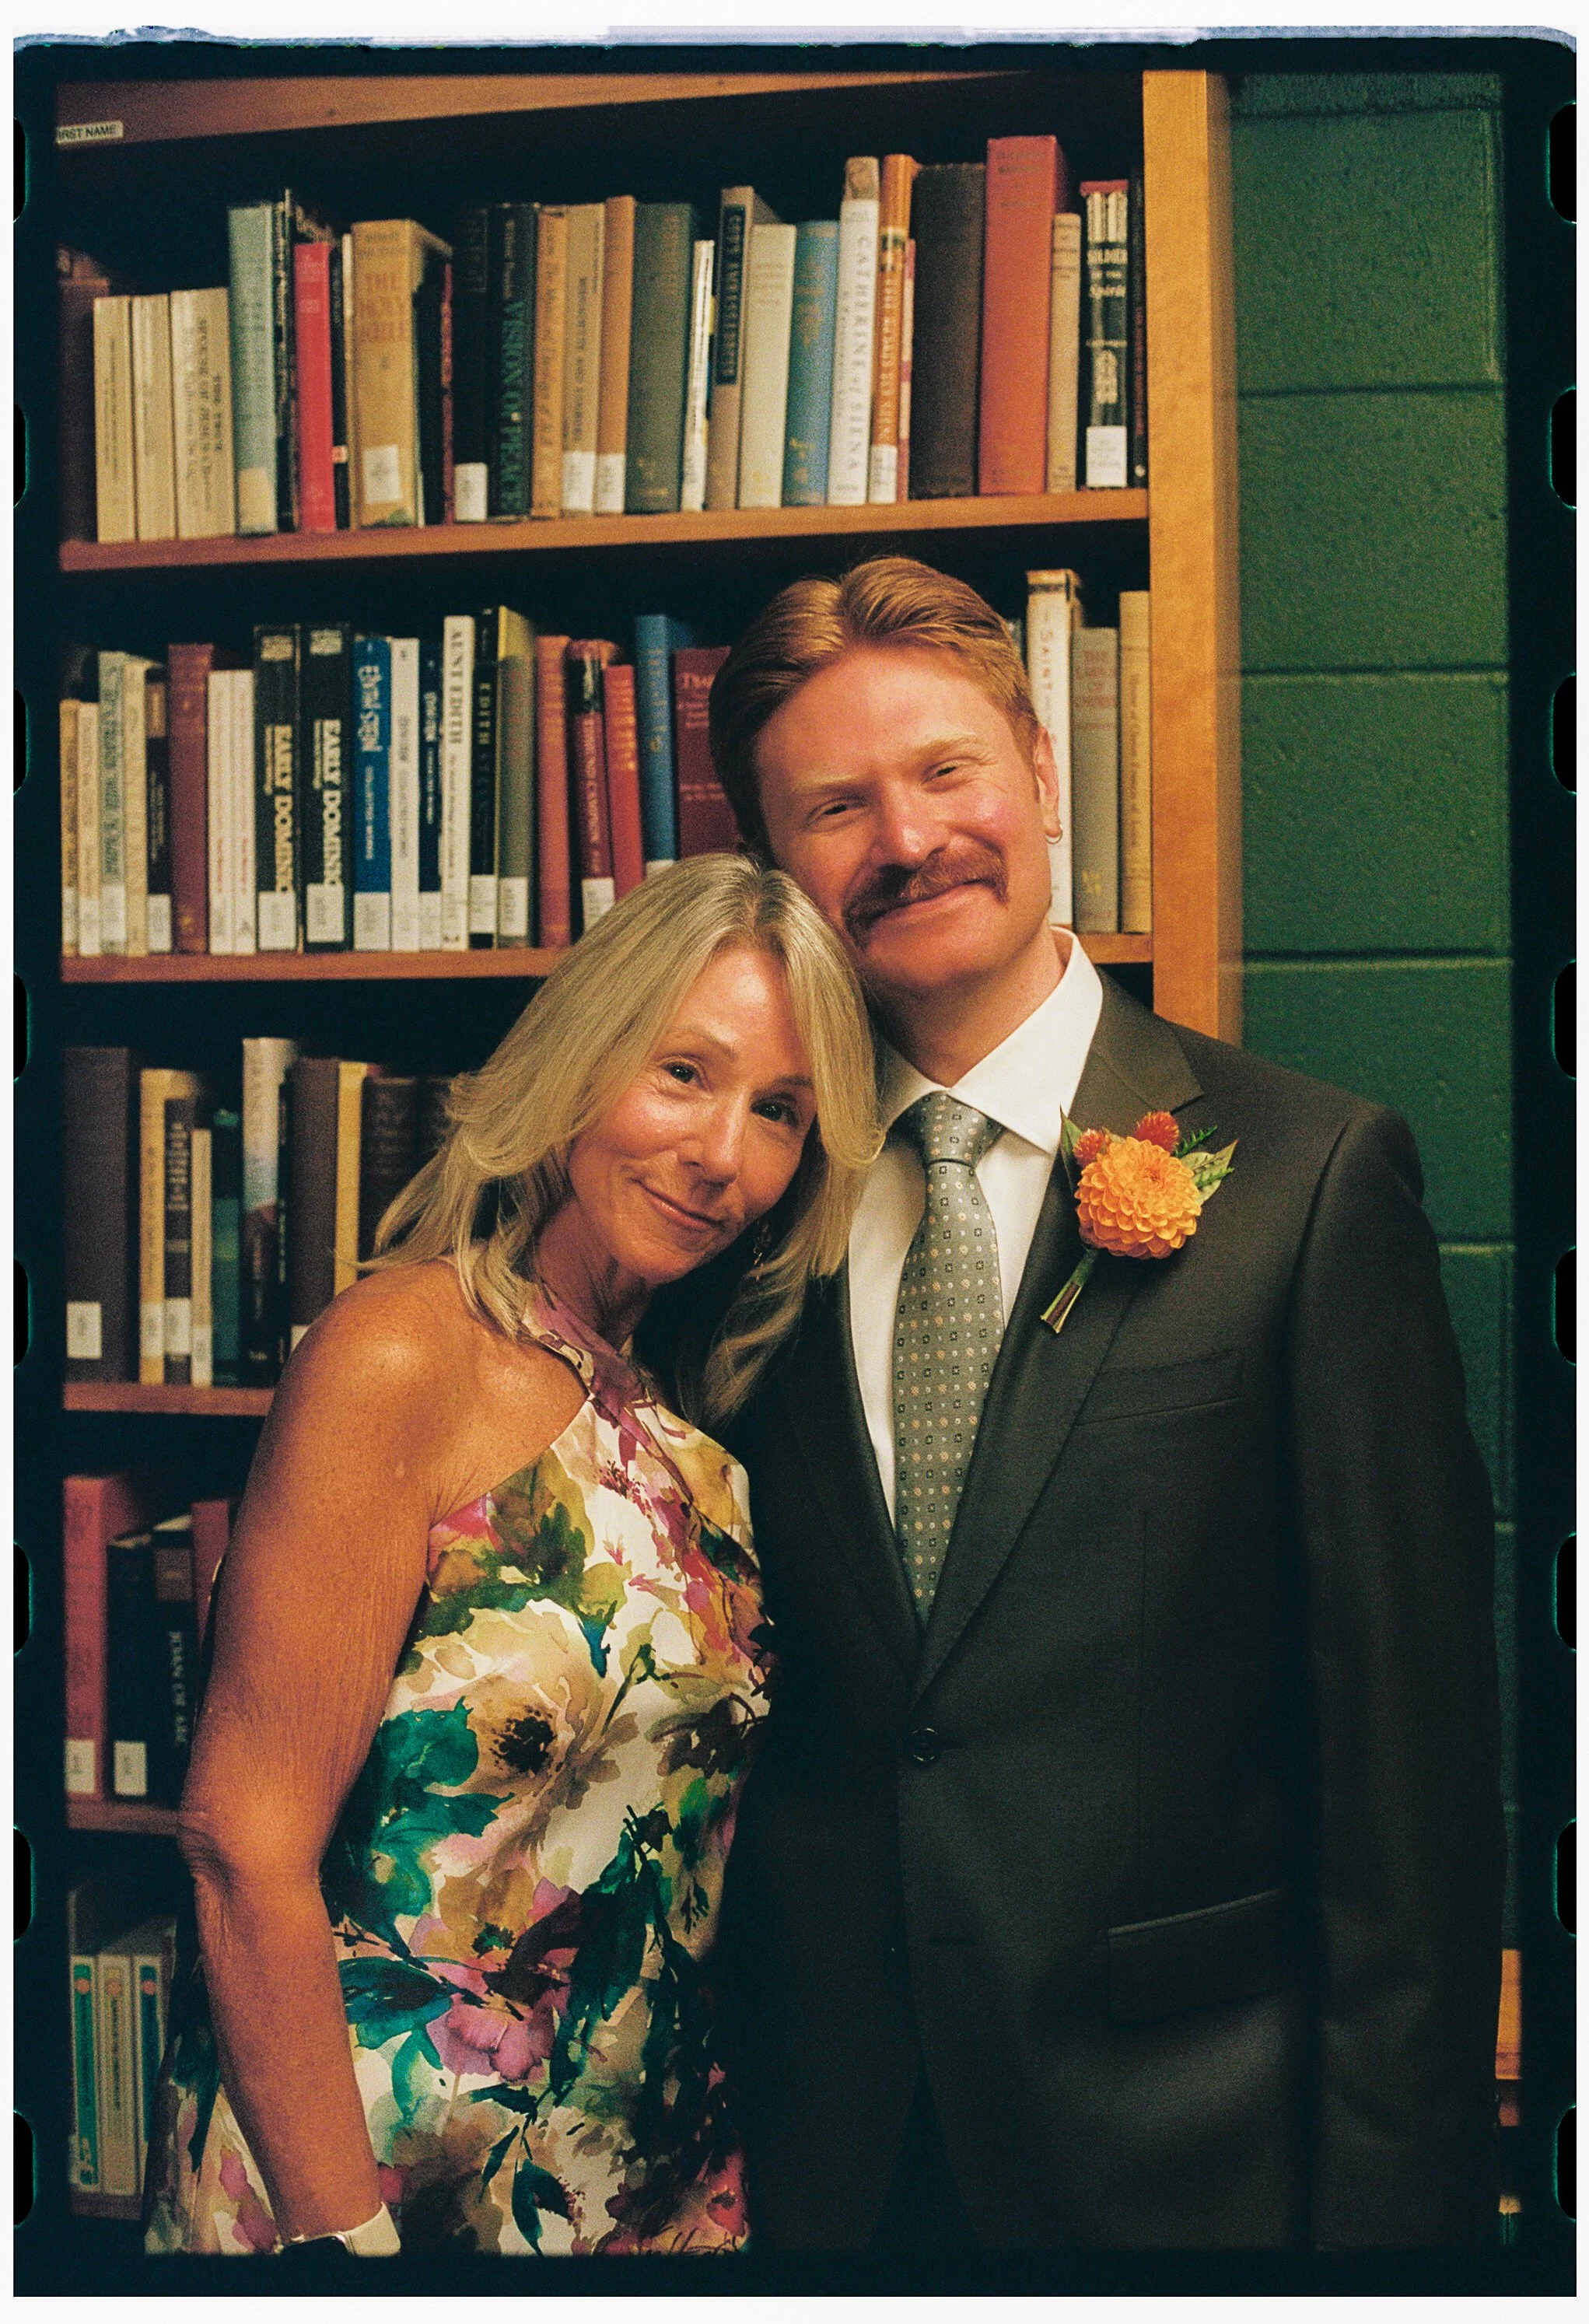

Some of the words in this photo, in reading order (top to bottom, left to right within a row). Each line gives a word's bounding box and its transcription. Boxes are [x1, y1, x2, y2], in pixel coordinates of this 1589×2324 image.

[86, 124, 116, 137] NAME
[852, 234, 872, 369] CATHERINE
[500, 300, 524, 384] VISION
[499, 425, 523, 513] PEACE
[847, 401, 867, 471] SIENA
[449, 627, 464, 681] AUNT
[449, 684, 464, 744] EDITH
[478, 682, 492, 745] EDITH
[275, 724, 292, 790] EARLY
[324, 718, 341, 786] EARLY
[168, 1631, 184, 1678] JOAN
